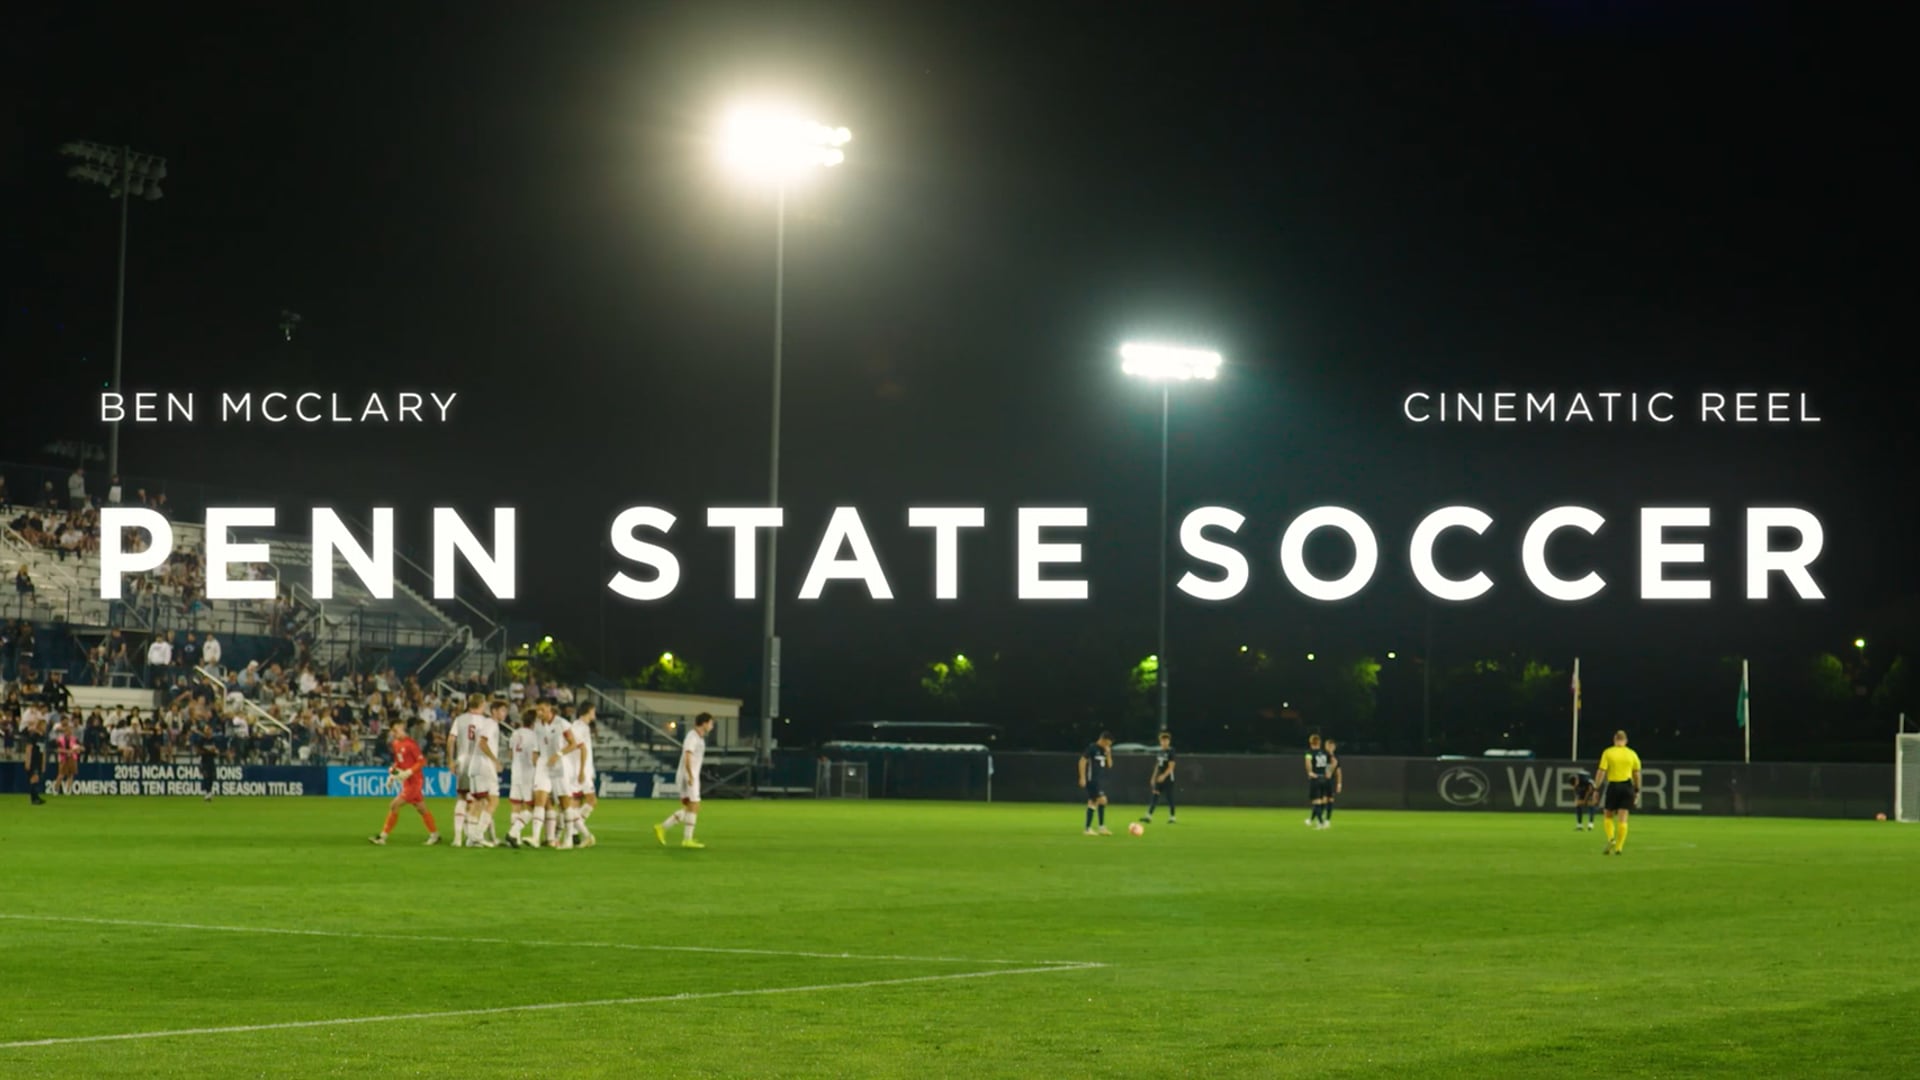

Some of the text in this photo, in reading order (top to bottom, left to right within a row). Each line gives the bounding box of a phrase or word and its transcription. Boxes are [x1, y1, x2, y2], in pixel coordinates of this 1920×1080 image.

[467, 724, 477, 740] 6
[114, 765, 243, 780] 2015 NCAA CHAIONS
[119, 781, 139, 795] BIG
[142, 782, 165, 795] TEN
[167, 782, 220, 795] REGULR
[221, 782, 266, 795] SEASON
[267, 782, 303, 795] TITLES
[1506, 766, 1703, 810] WE RE
